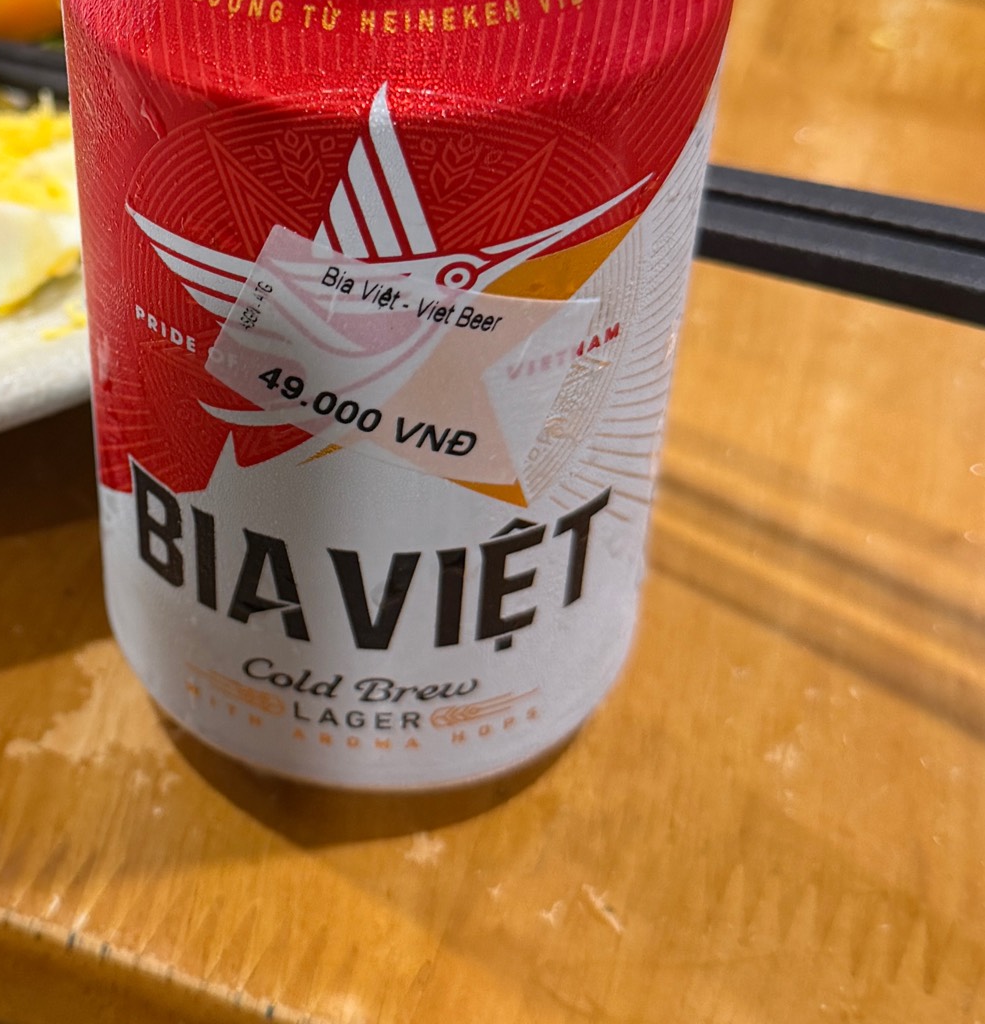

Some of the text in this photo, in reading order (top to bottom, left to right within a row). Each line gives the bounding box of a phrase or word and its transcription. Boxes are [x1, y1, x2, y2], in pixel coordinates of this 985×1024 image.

[303, 0, 341, 31] TỪ
[321, 266, 354, 294] Bia
[361, 279, 401, 310] Việt
[417, 298, 455, 324] Viet
[456, 307, 503, 332] Beer
[135, 304, 196, 353] PRIDE
[258, 367, 477, 456] 49.000 VNĐ
[131, 459, 612, 652] BIA VIỆT
[242, 657, 480, 703] Cold Brew
[292, 728, 420, 750] AROMA
[451, 707, 540, 744] HOPS
[293, 701, 422, 730] LAGER
